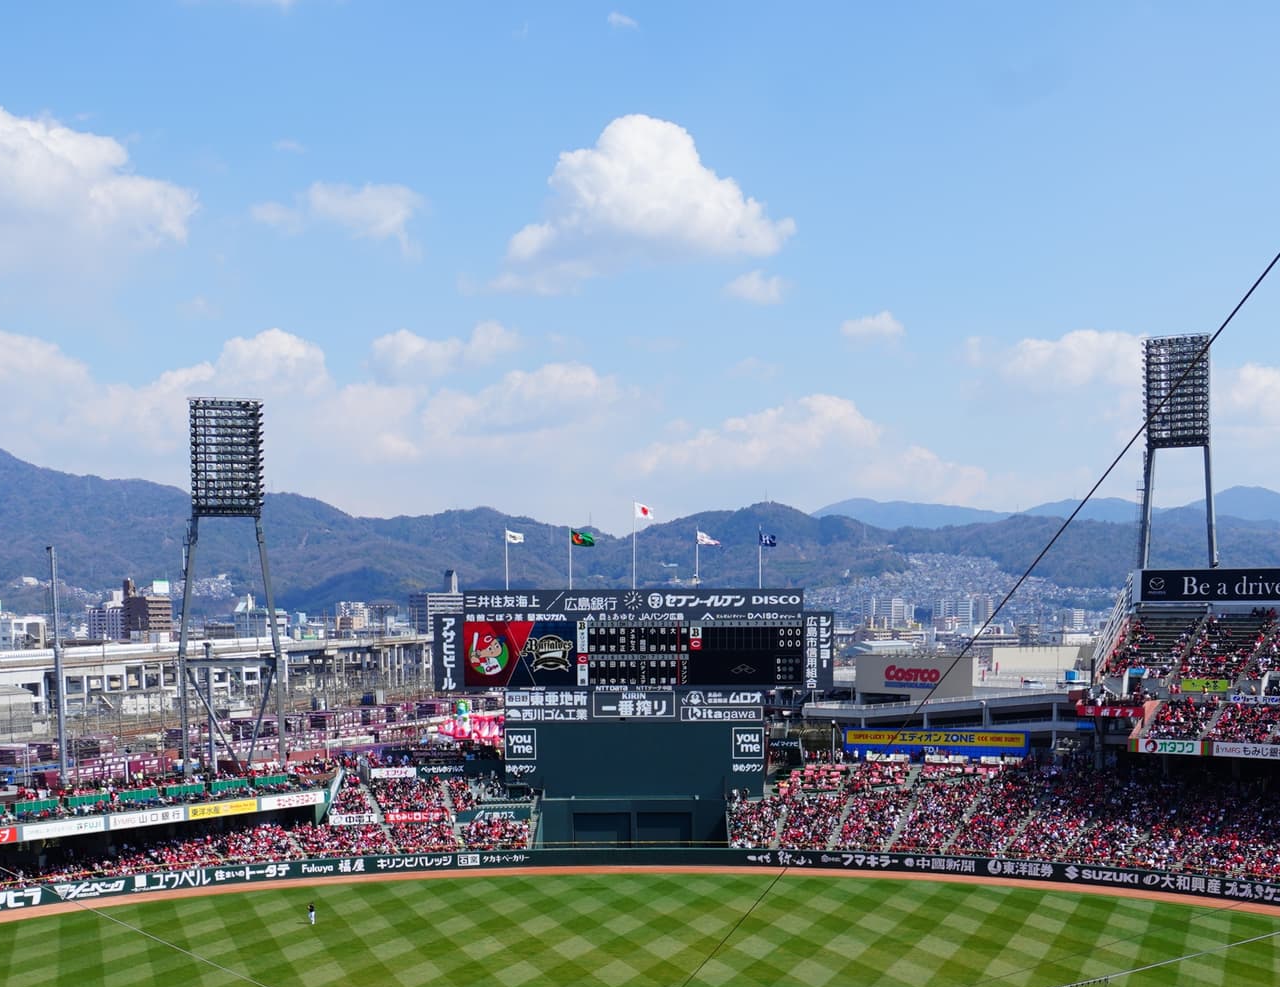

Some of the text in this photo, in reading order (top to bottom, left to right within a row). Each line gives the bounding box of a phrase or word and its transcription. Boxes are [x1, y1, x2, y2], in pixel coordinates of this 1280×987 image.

[1183, 576, 1210, 596] Be
[1217, 582, 1228, 596] a
[465, 595, 540, 609] 三井住友海上
[564, 597, 618, 611] 広島銀行
[751, 595, 801, 605] DISCO
[441, 617, 456, 691] アサヒビール
[806, 616, 818, 689] 広島市信用組合
[522, 709, 588, 721] 西川ゴム工業
[602, 700, 667, 717] 一番搾り
[508, 735, 531, 746] you
[736, 733, 759, 745] you
[899, 733, 941, 742] エディオン
[944, 734, 975, 743] ZONE
[513, 745, 533, 754] me
[740, 743, 761, 753] me
[1157, 741, 1195, 754] オタフク
[732, 764, 763, 772] ゆめタウン
[376, 855, 452, 869] キリンビバレッジ
[482, 854, 530, 864] タカキベーカリー
[841, 854, 899, 867] フマキラー
[301, 863, 334, 875] Fukuya
[1003, 861, 1054, 878] 東洋証券
[150, 869, 212, 889] ユウベル
[1081, 869, 1139, 884] SUZUKI
